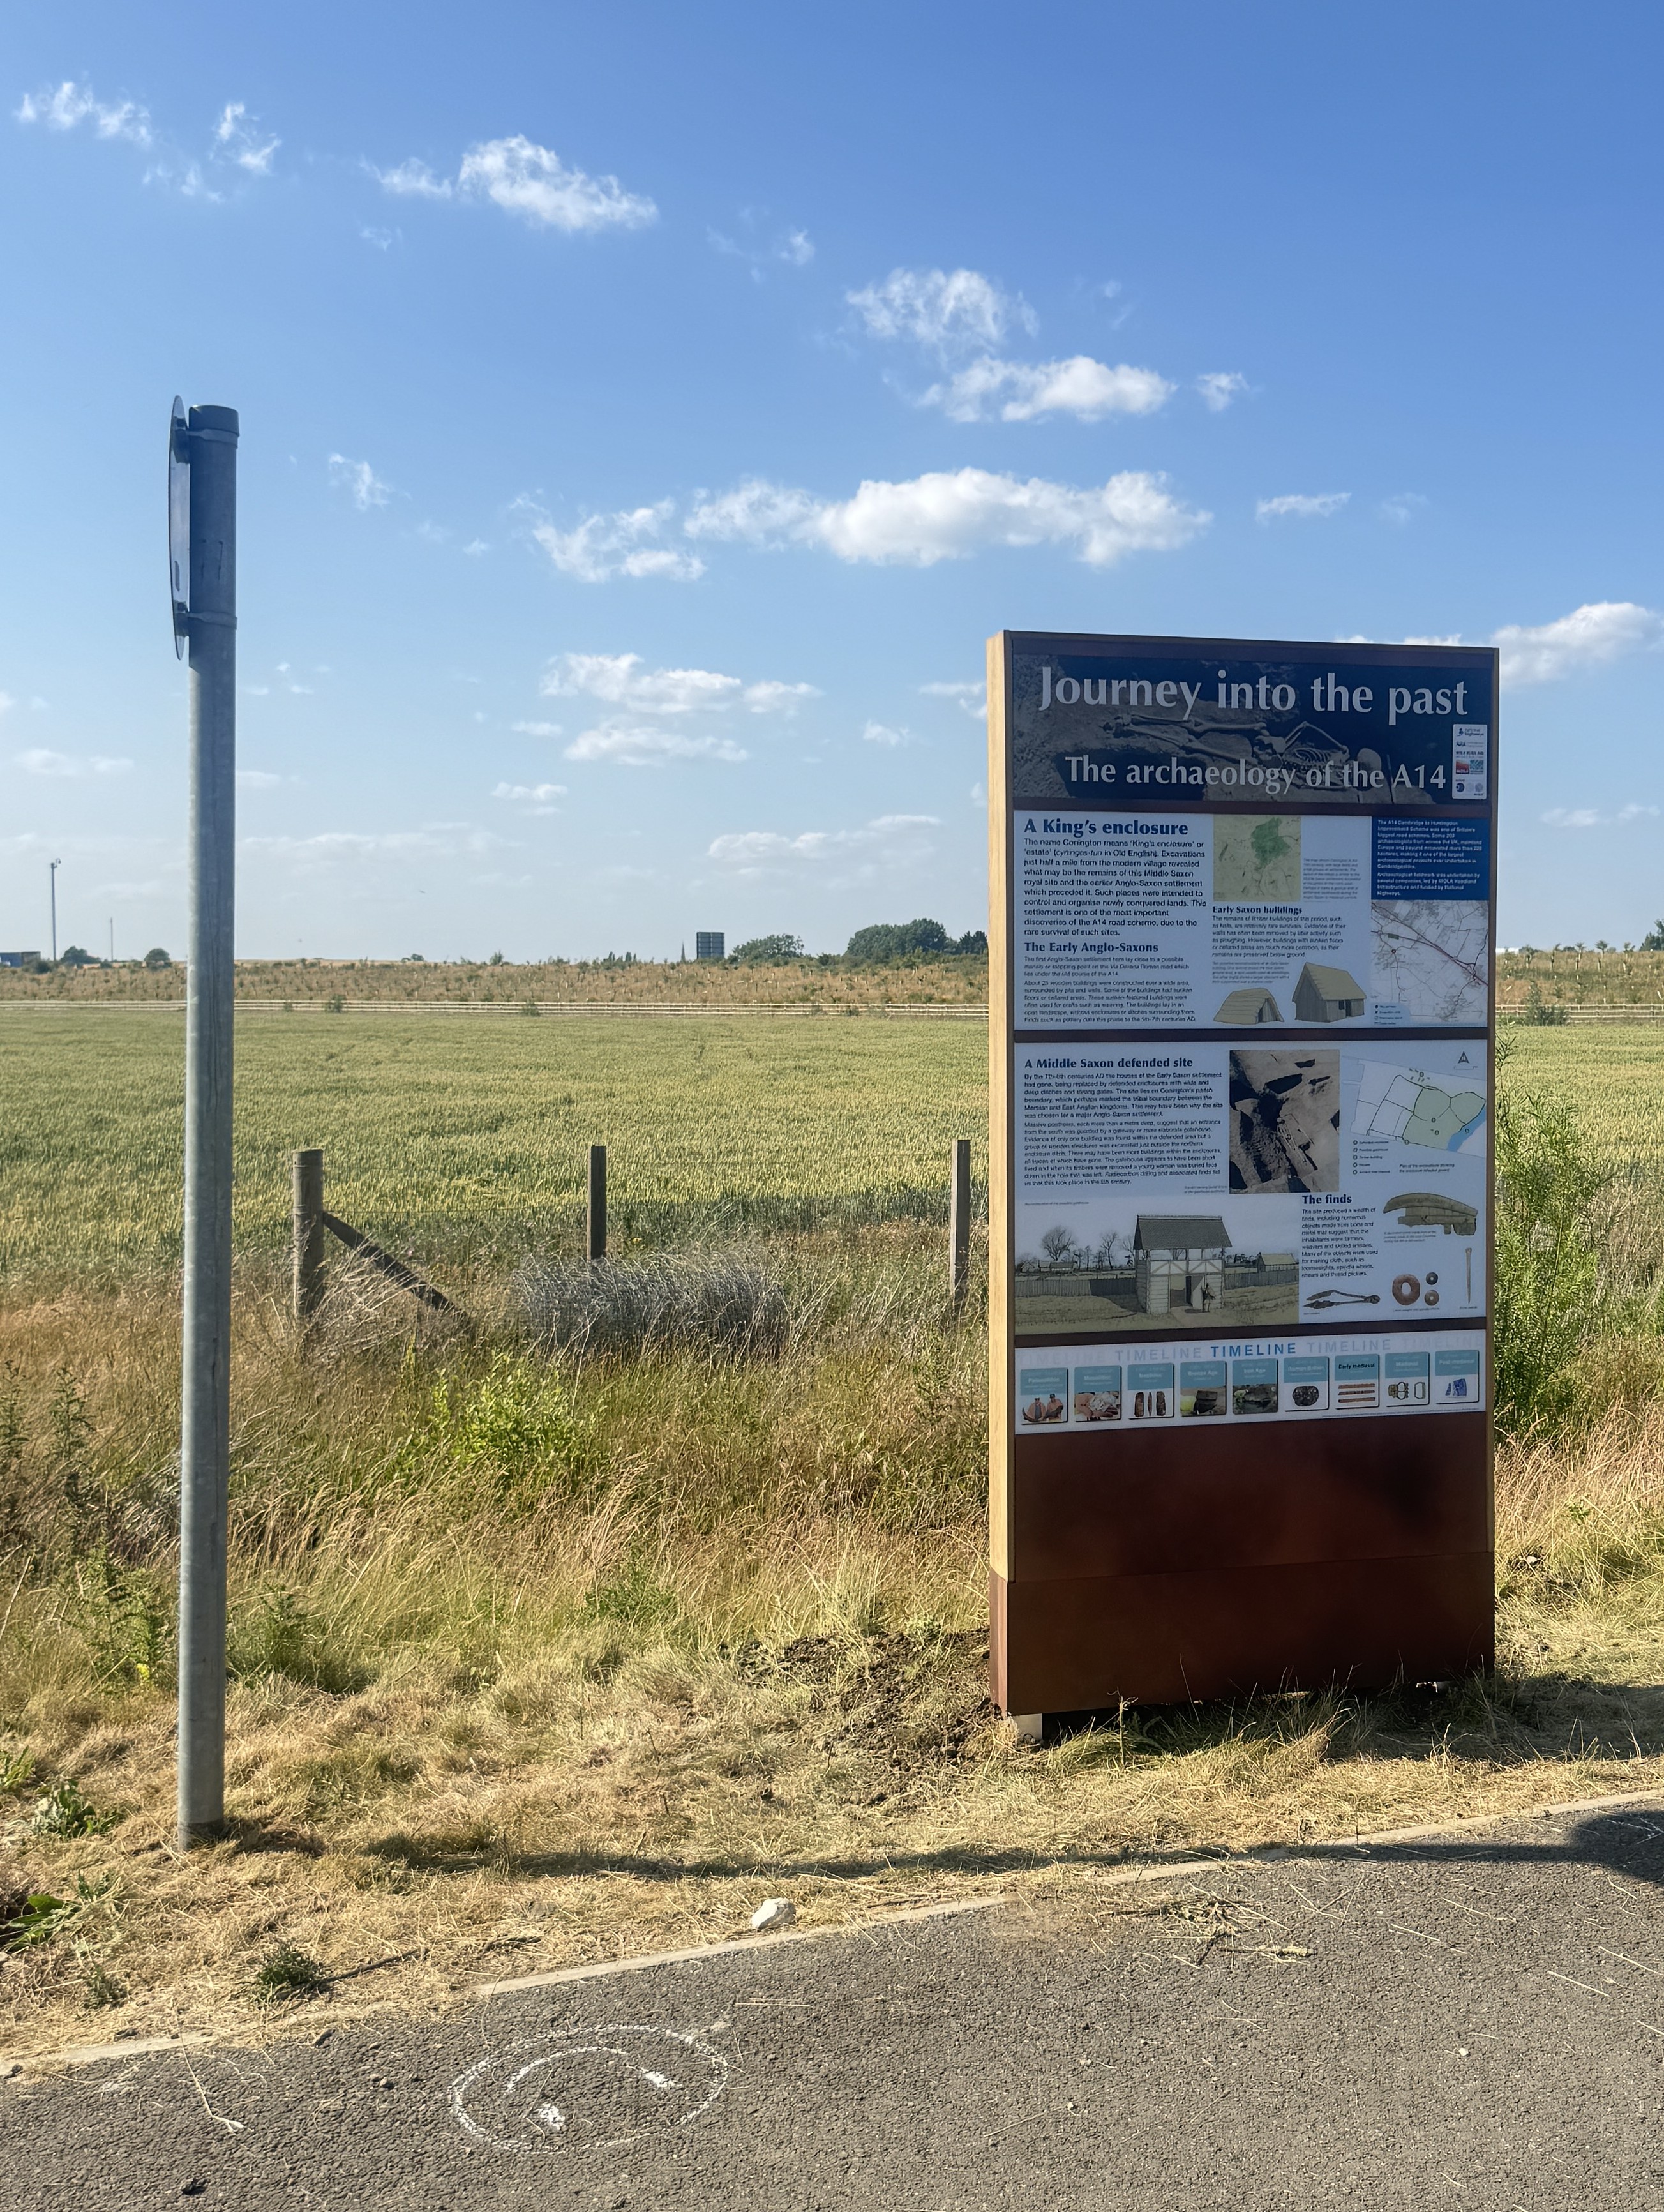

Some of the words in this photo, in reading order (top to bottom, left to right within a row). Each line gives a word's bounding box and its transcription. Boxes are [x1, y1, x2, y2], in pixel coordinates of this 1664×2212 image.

[1038, 666, 1201, 719] Journey
[1217, 670, 1296, 710] into
[1310, 672, 1373, 713] the
[1388, 681, 1468, 726] past
[1065, 756, 1116, 783] The
[1126, 756, 1296, 795] archaeology
[1305, 760, 1337, 788] of
[1342, 760, 1384, 788] the
[1391, 764, 1446, 790] A14
[1024, 818, 1037, 832] A
[1043, 818, 1097, 838] King's
[1102, 820, 1188, 834] enclosure
[1143, 860, 1166, 868] village
[1114, 879, 1162, 887] Anglo-Saxon
[1213, 906, 1234, 915] Early
[1263, 906, 1302, 915] buildings
[1024, 942, 1045, 951] The
[1049, 942, 1077, 954] Early
[1081, 942, 1158, 954] Anglo-Saxons
[1024, 1059, 1033, 1067] A
[1036, 1058, 1077, 1067] Middle
[1080, 1059, 1113, 1067] Saxon
[1117, 1058, 1169, 1067] defended
[1173, 1057, 1192, 1067] site
[1301, 1194, 1322, 1203] The
[1325, 1194, 1352, 1203] finds
[1211, 1343, 1296, 1357] TIMELINE
[1307, 1339, 1390, 1353] TIMELINE
[1115, 1347, 1201, 1361] TIMELINE
